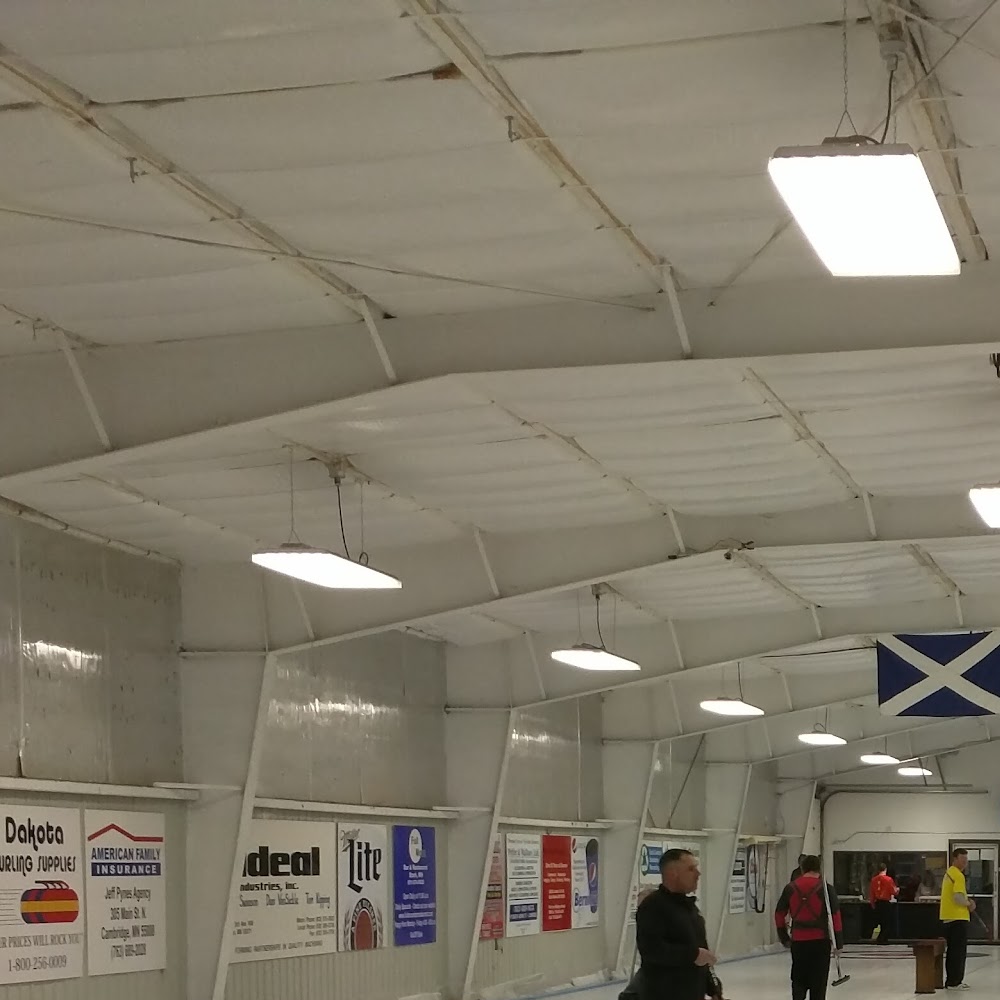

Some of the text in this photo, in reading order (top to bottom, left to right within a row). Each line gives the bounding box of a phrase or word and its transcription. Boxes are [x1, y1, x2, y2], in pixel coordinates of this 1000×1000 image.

[6, 816, 64, 851] Dakota
[91, 847, 161, 860] AMERICAN FAMILY
[37, 855, 76, 872] SUPPLIES
[96, 864, 157, 874] INSURANCE
[342, 839, 382, 893] Lite
[240, 882, 283, 891] ndustries,
[9, 936, 31, 947] PRICES
[33, 934, 49, 946] WILL
[50, 933, 67, 945] ROCK
